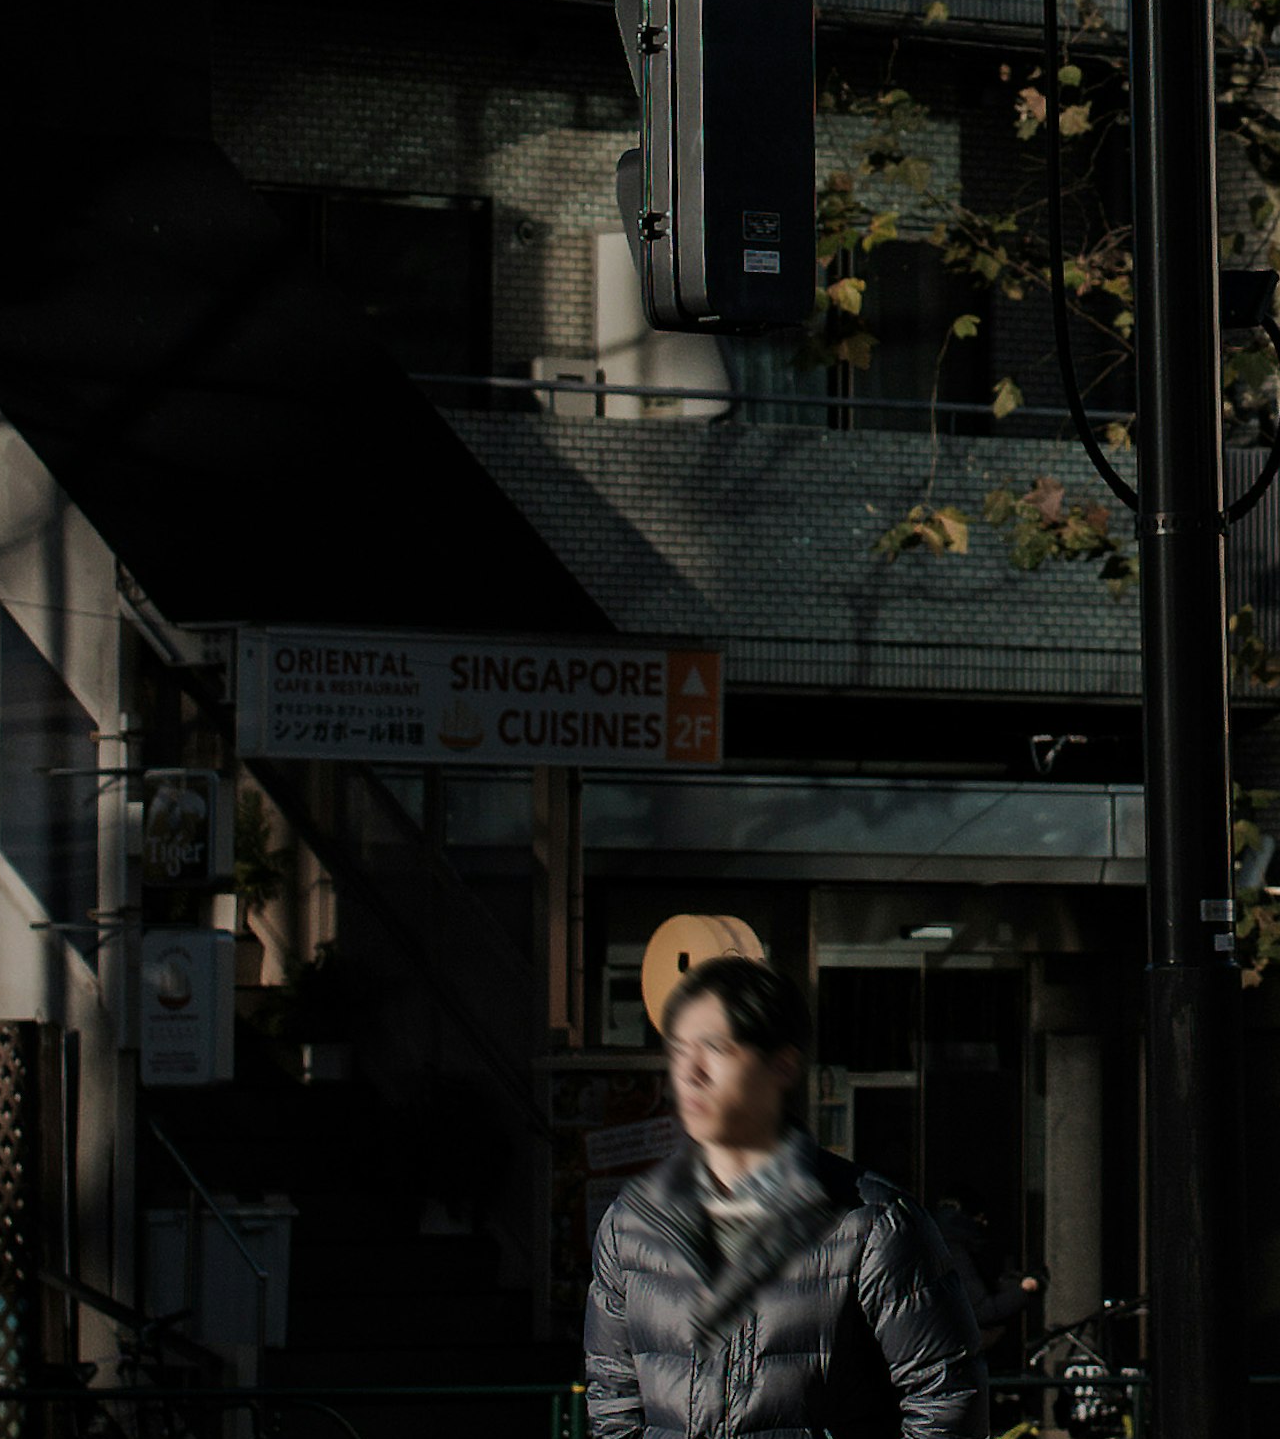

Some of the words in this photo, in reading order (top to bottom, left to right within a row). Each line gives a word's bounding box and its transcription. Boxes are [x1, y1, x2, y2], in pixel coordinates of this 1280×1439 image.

[274, 647, 414, 677] ORIENTAL
[450, 654, 663, 697] SINGAPORE
[274, 678, 310, 694] CAFE
[330, 680, 421, 697] RESTAURANT
[498, 709, 662, 751] CUISINES
[673, 712, 713, 751] 2F
[147, 834, 205, 877] Tiger
